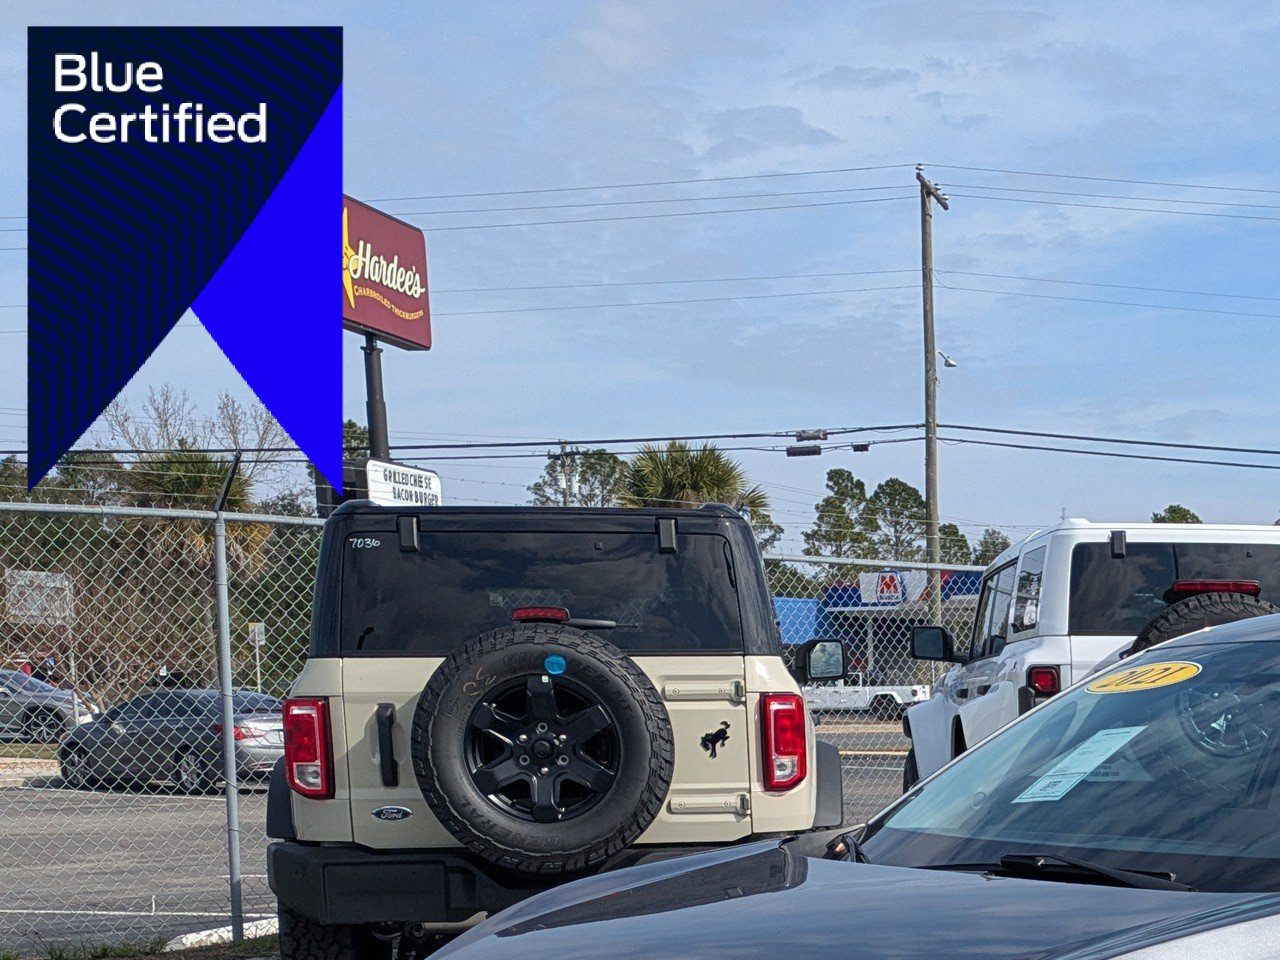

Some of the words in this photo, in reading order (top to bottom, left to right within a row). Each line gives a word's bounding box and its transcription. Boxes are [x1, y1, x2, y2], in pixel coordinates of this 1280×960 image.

[349, 240, 426, 299] Hardee's
[392, 486, 413, 502] BACON
[349, 538, 381, 549] 7036
[1095, 666, 1189, 689] 2021
[380, 809, 403, 819] Ford
